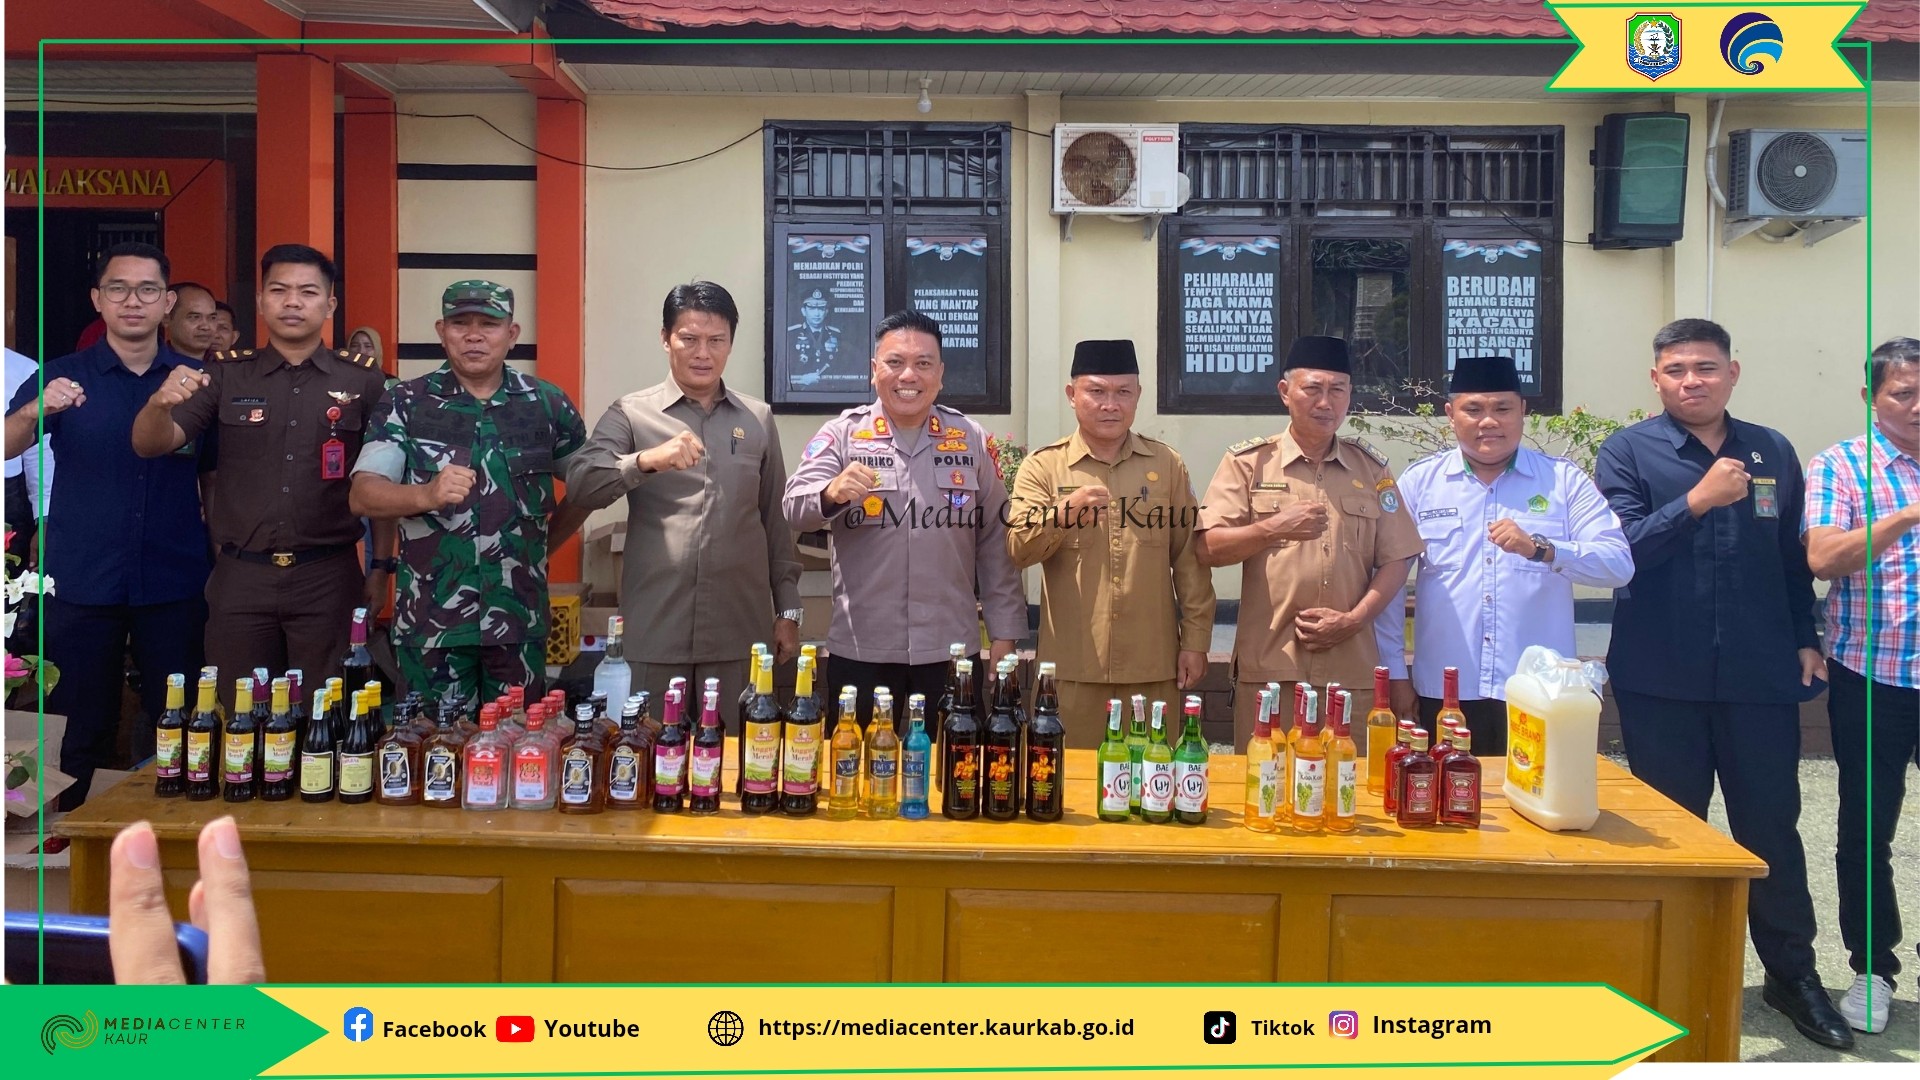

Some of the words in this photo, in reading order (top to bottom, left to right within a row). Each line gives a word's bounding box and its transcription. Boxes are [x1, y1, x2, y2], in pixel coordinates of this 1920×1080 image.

[793, 262, 840, 271] MENJADIKAN
[842, 262, 864, 271] POLRI
[1184, 273, 1274, 287] PELIHARALAH
[1447, 276, 1535, 296] BERUBAH
[1184, 288, 1224, 296] TEMPAT
[1226, 288, 1273, 296] KERJAMU
[914, 300, 938, 310] YANG
[940, 300, 978, 310] MANTAP
[1184, 297, 1223, 308] JAGA
[1227, 297, 1273, 308] NAMA
[1448, 297, 1498, 306] MEMANG
[1500, 297, 1535, 307] BERAT
[948, 312, 978, 320] DENGAN
[1185, 310, 1273, 324] BAIKNYA
[1448, 308, 1478, 317] PADA
[1480, 308, 1534, 318] AWALNYA
[1448, 317, 1534, 328] KACAU
[1185, 325, 1240, 334] SEKALIPUN
[1242, 325, 1273, 334] TIDAK
[942, 338, 978, 348] MATANG
[1448, 336, 1476, 348] DAN
[1478, 336, 1533, 348] SANGAT
[1185, 344, 1202, 352] TAPI
[1204, 344, 1222, 352] BISA
[1224, 344, 1273, 352] MEMBUATMU
[1186, 354, 1274, 373] HIDUP
[934, 455, 974, 467] POLRI
